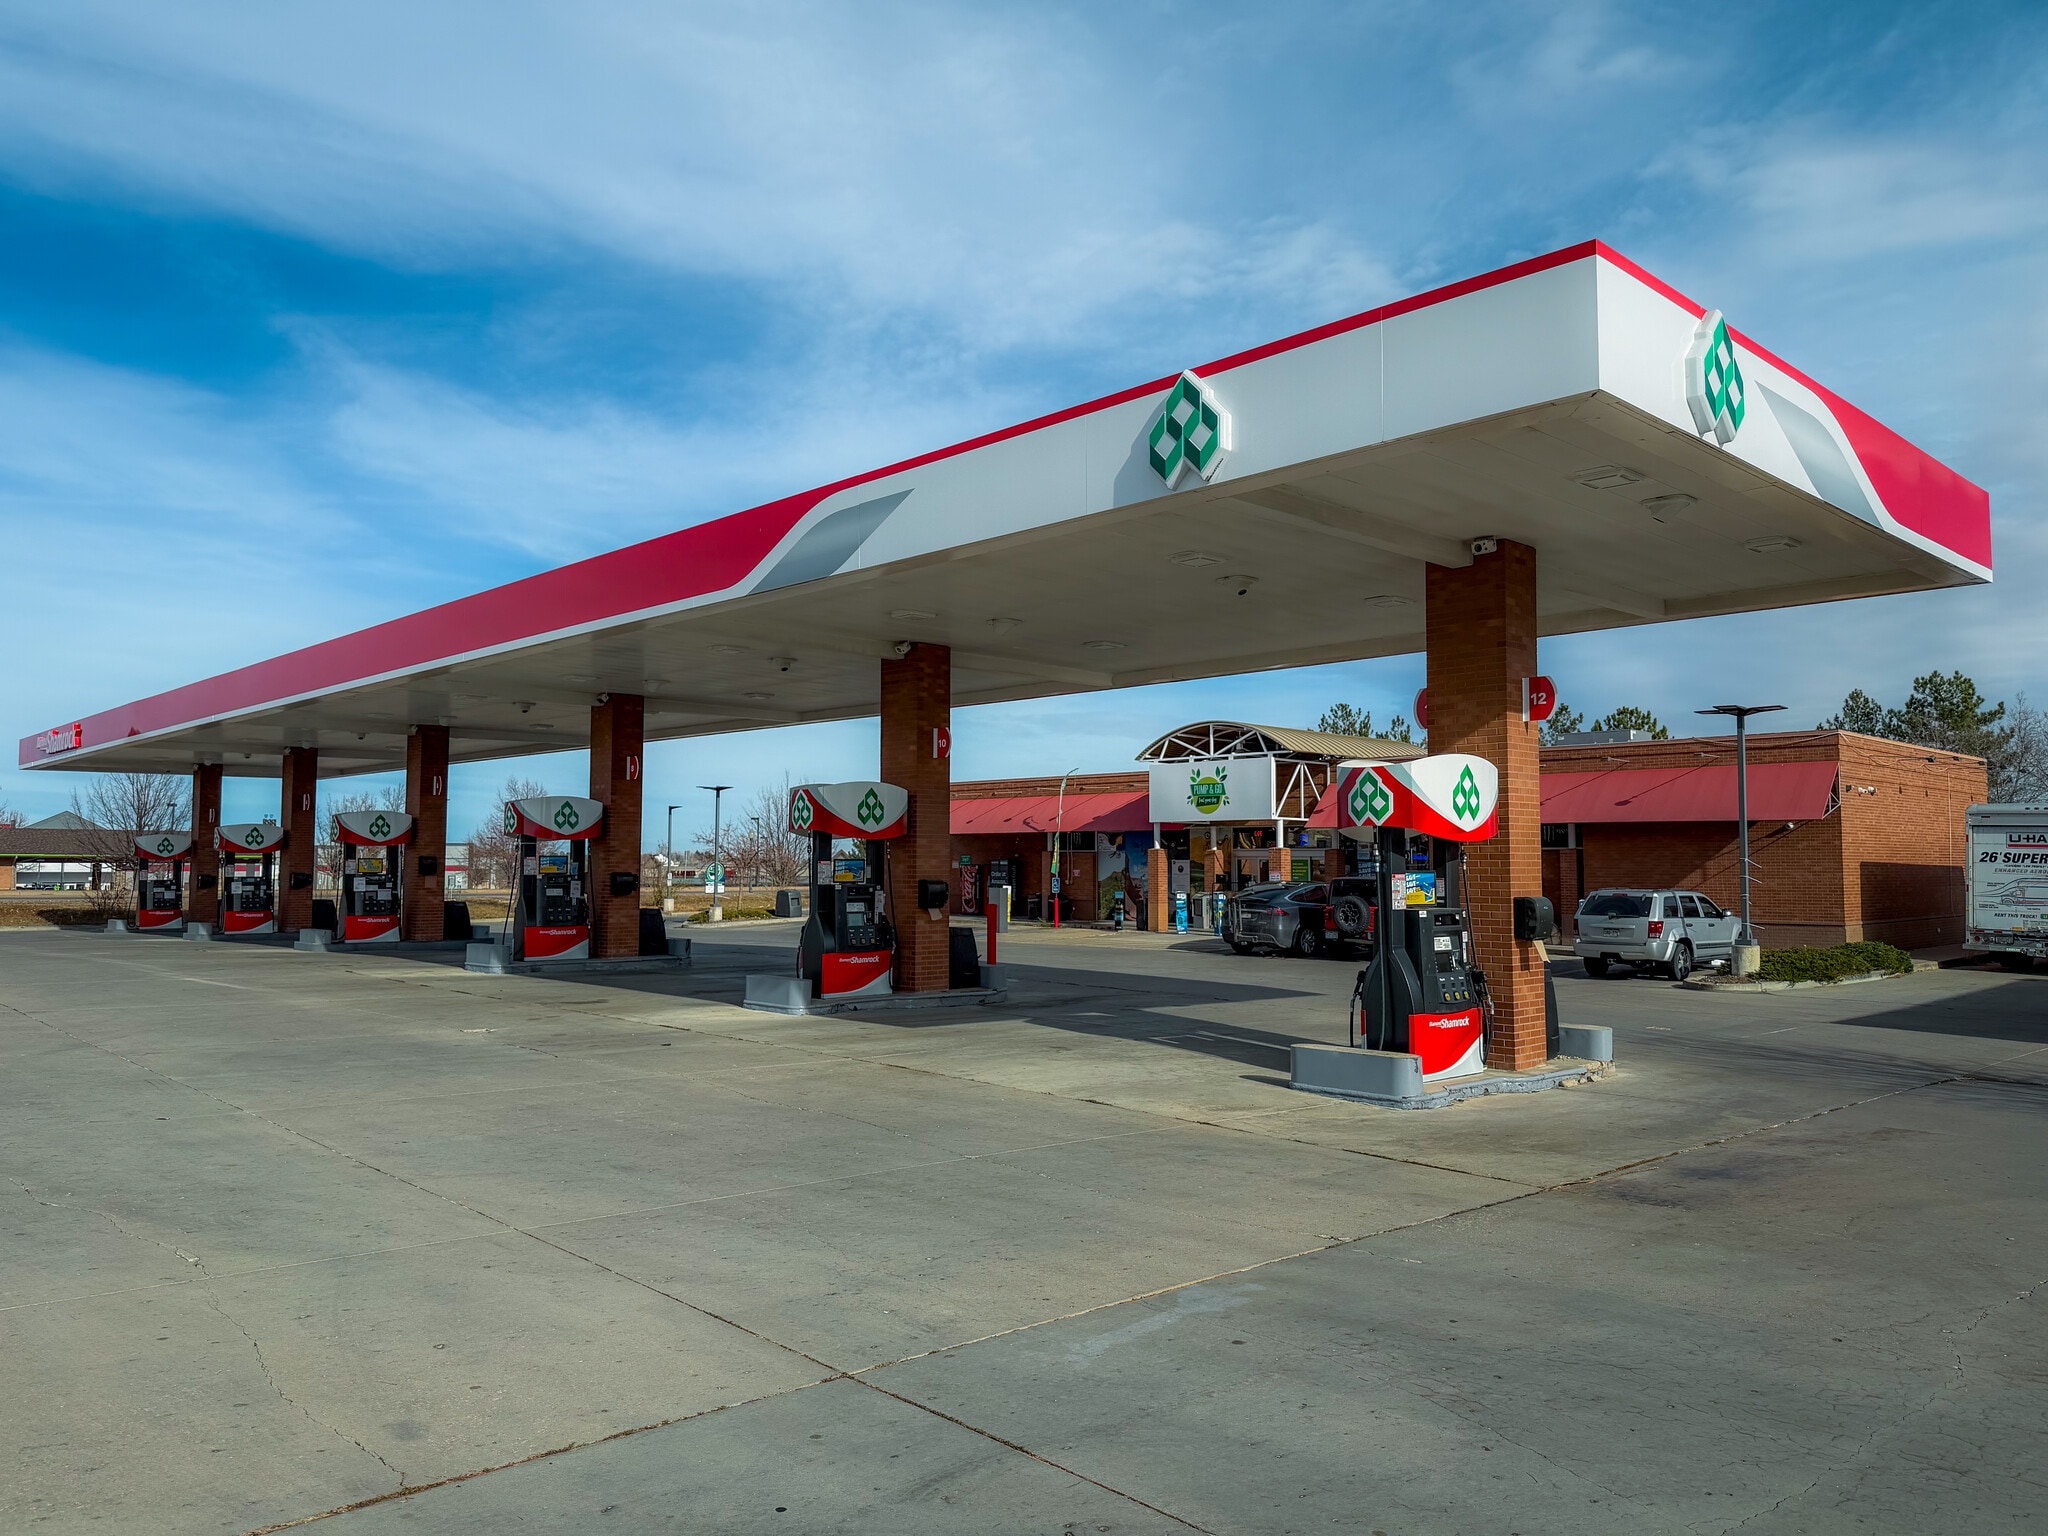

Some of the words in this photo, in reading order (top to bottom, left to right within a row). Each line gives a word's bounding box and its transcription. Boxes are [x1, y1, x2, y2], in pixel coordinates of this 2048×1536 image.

[1530, 692, 1547, 704] 12
[938, 739, 947, 748] 10
[1194, 784, 1208, 795] PUMP
[1209, 784, 1214, 794] &
[1214, 784, 1223, 794] GO
[2002, 852, 2048, 864] SUPER
[850, 955, 880, 964] Shamrock
[1440, 1016, 1470, 1029] Shamrock
